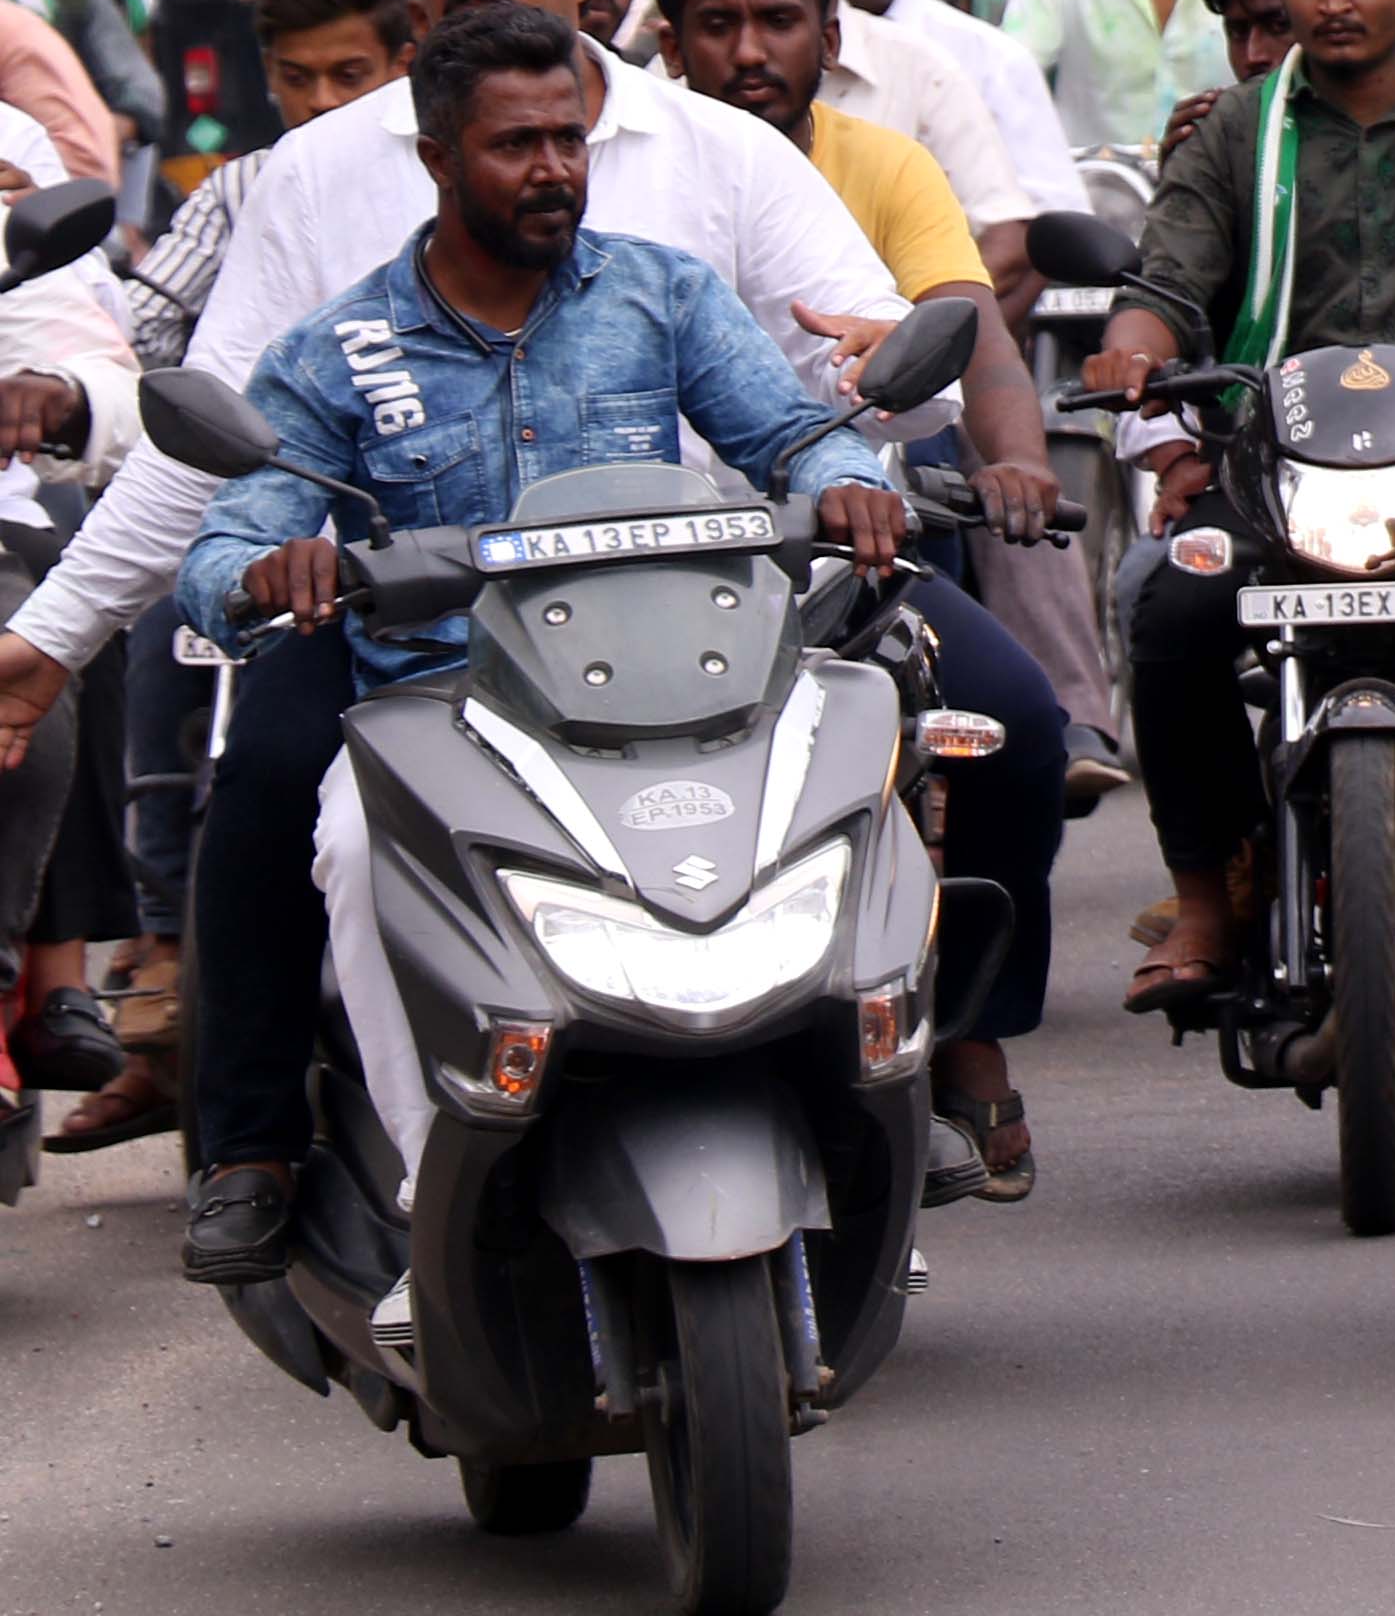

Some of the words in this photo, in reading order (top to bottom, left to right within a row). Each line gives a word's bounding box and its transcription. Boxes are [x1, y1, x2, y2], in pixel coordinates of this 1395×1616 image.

[526, 533, 571, 559] KA
[685, 515, 770, 545] 1953
[1273, 593, 1307, 619] KA
